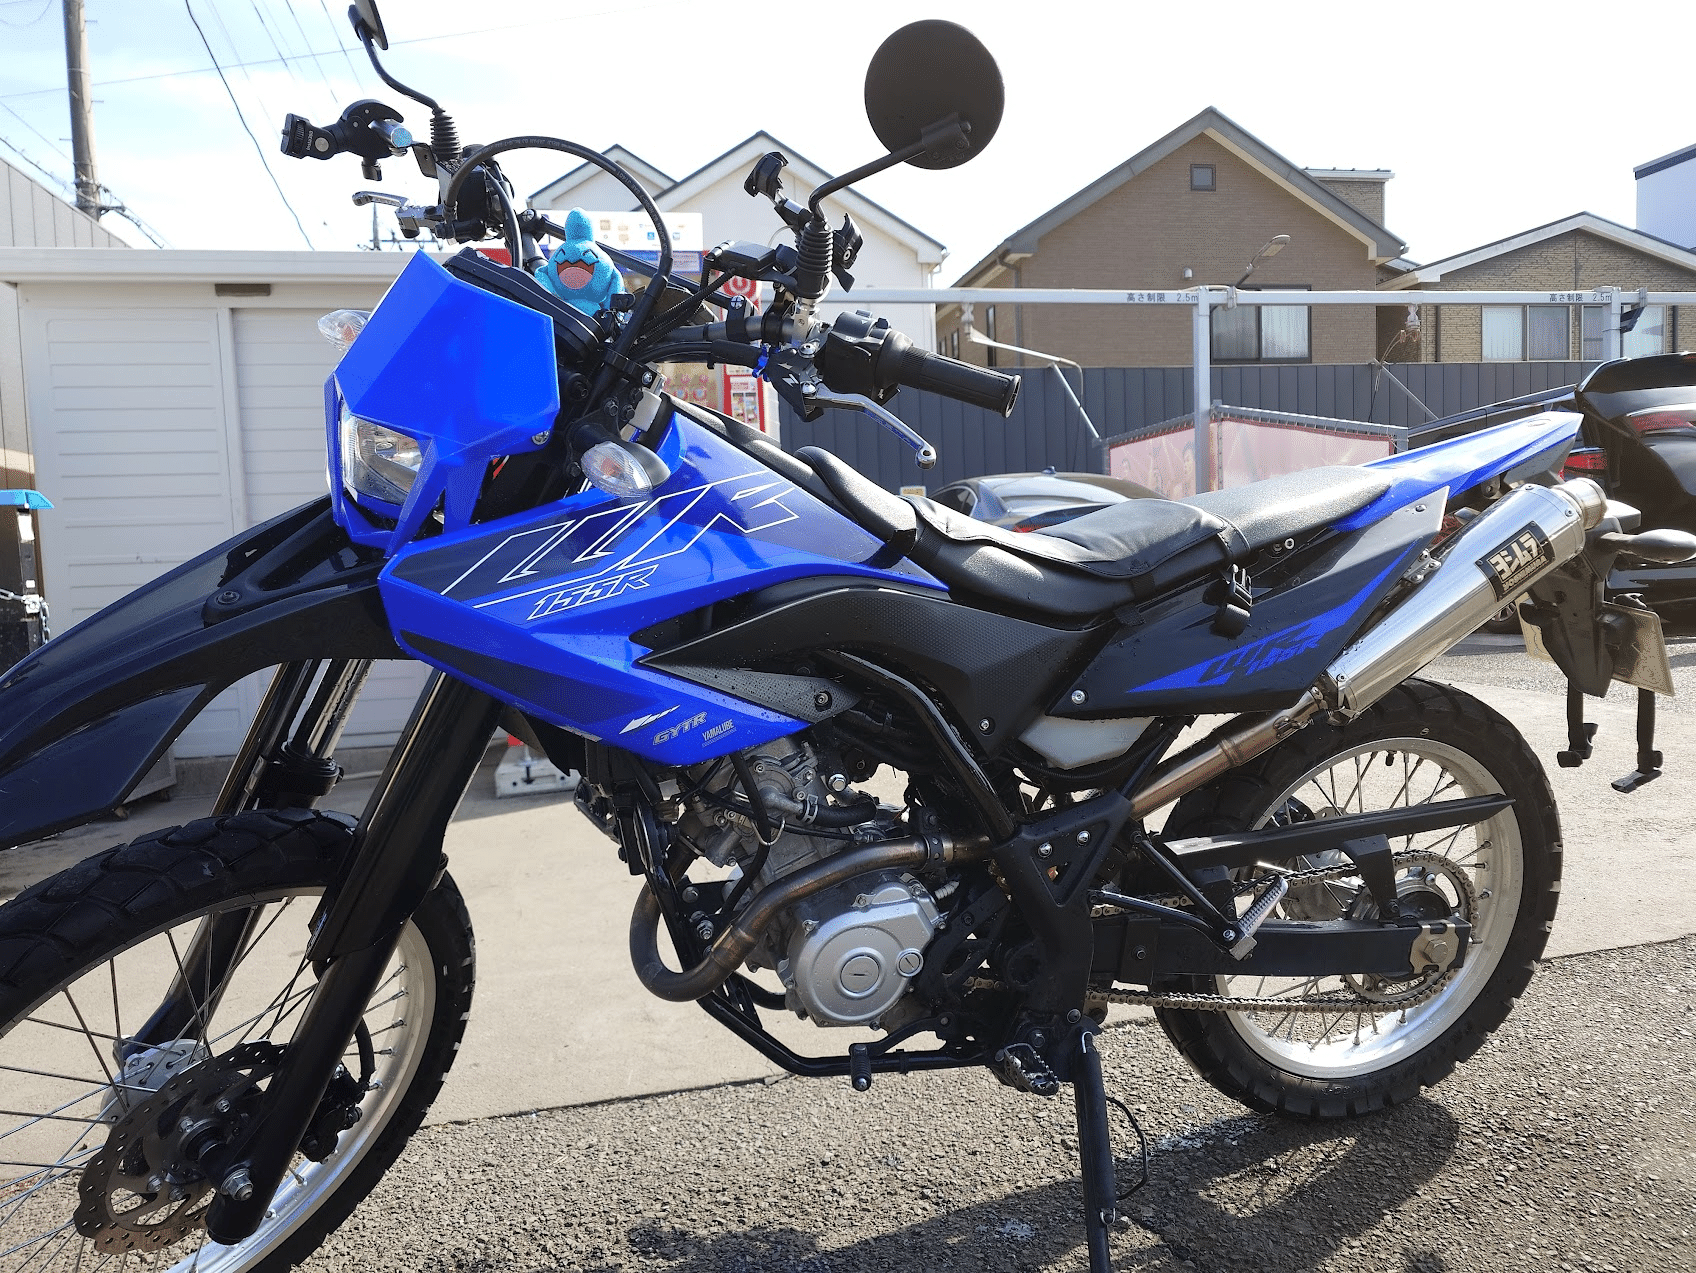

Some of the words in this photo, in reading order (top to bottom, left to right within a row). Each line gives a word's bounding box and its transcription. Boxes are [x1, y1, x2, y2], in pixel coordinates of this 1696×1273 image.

[1126, 292, 1165, 302] 高さ制限
[1177, 292, 1199, 302] 2.5m
[1549, 293, 1583, 302] 高さ制限
[1592, 293, 1612, 302] 2.5m
[1489, 532, 1539, 581] ヨシムラ
[526, 563, 660, 621] 155R
[652, 711, 708, 746] GYTR
[702, 719, 735, 742] YAMALUBE
